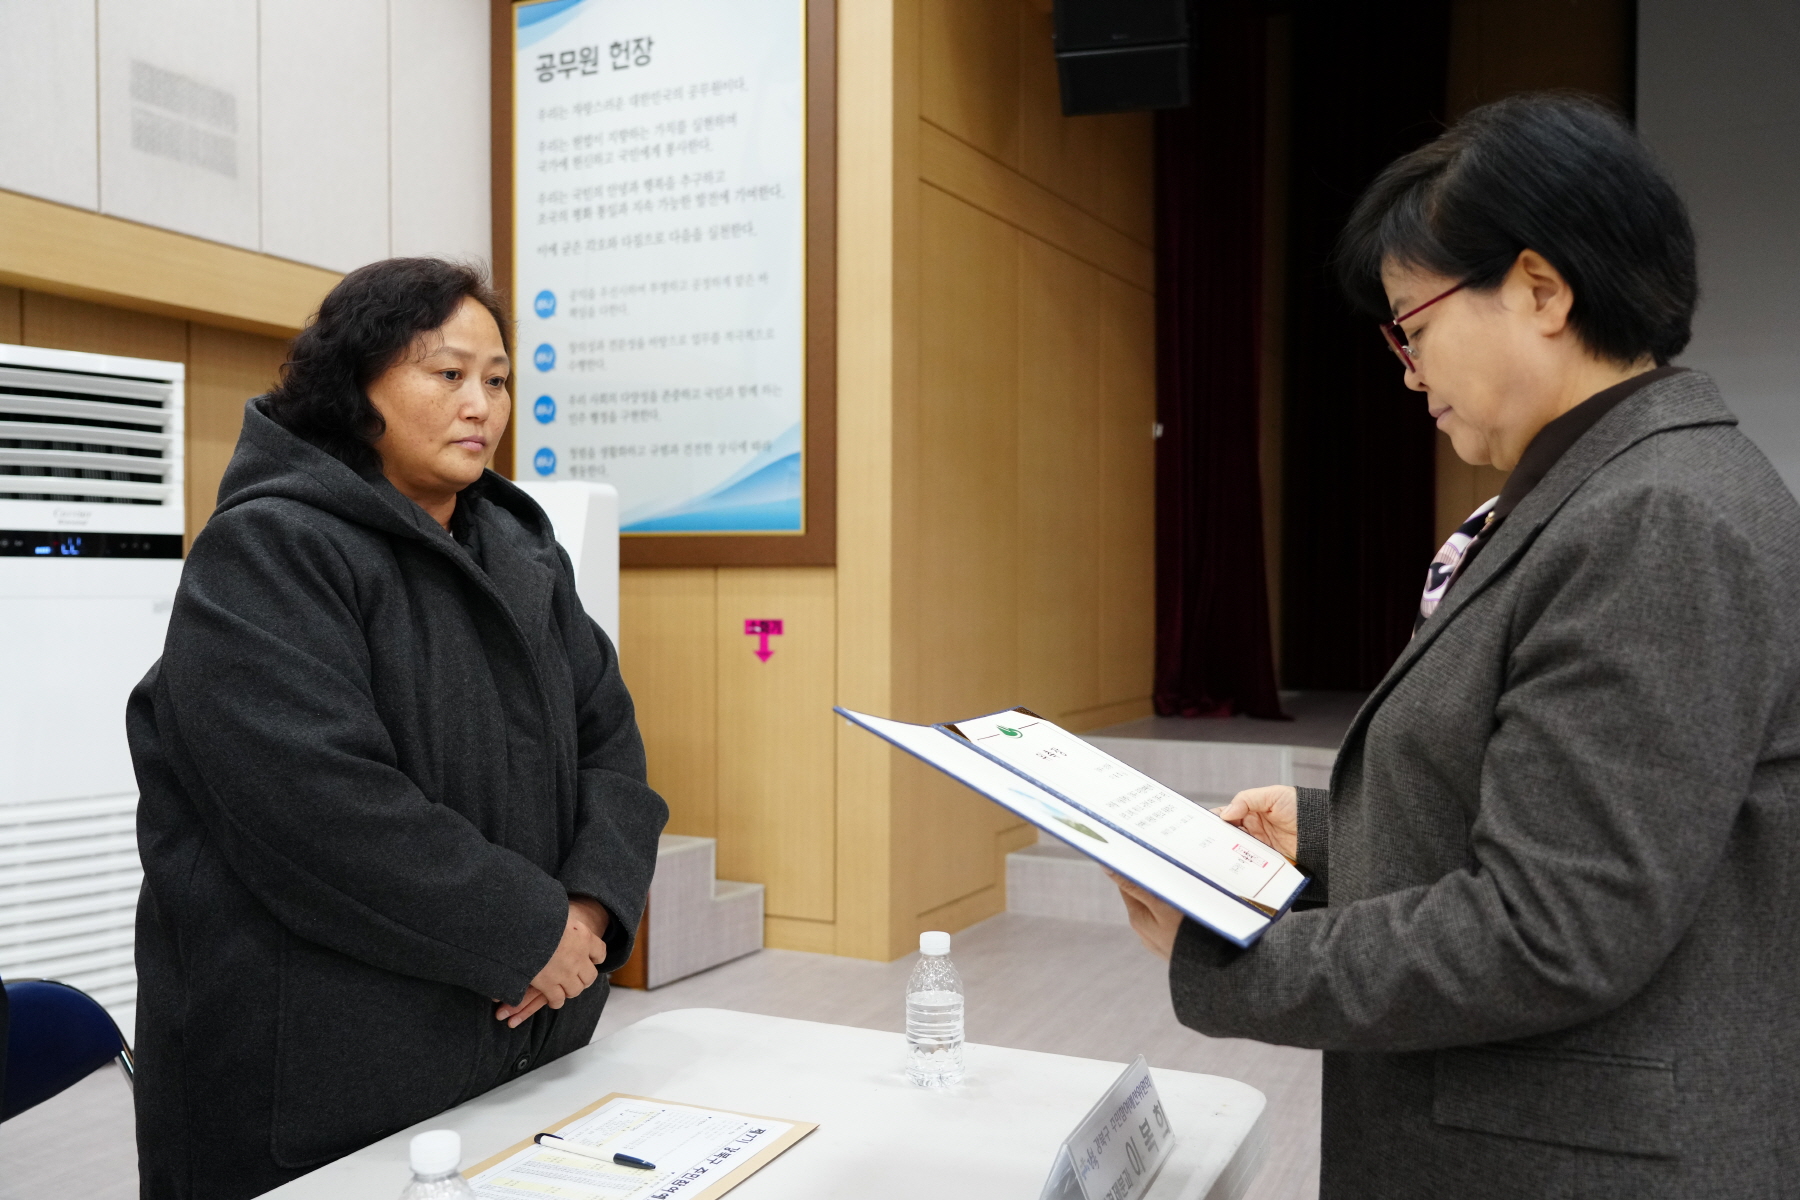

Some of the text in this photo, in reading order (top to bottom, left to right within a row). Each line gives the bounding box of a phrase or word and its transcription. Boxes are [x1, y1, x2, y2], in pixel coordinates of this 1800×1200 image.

[535, 36, 655, 83] 공무원 헌장
[1093, 1125, 1111, 1155] 강북구
[1109, 1074, 1152, 1133] 주민참여예산위원회
[706, 1146, 741, 1165] 강북구
[648, 1166, 709, 1200] 주민참여예
